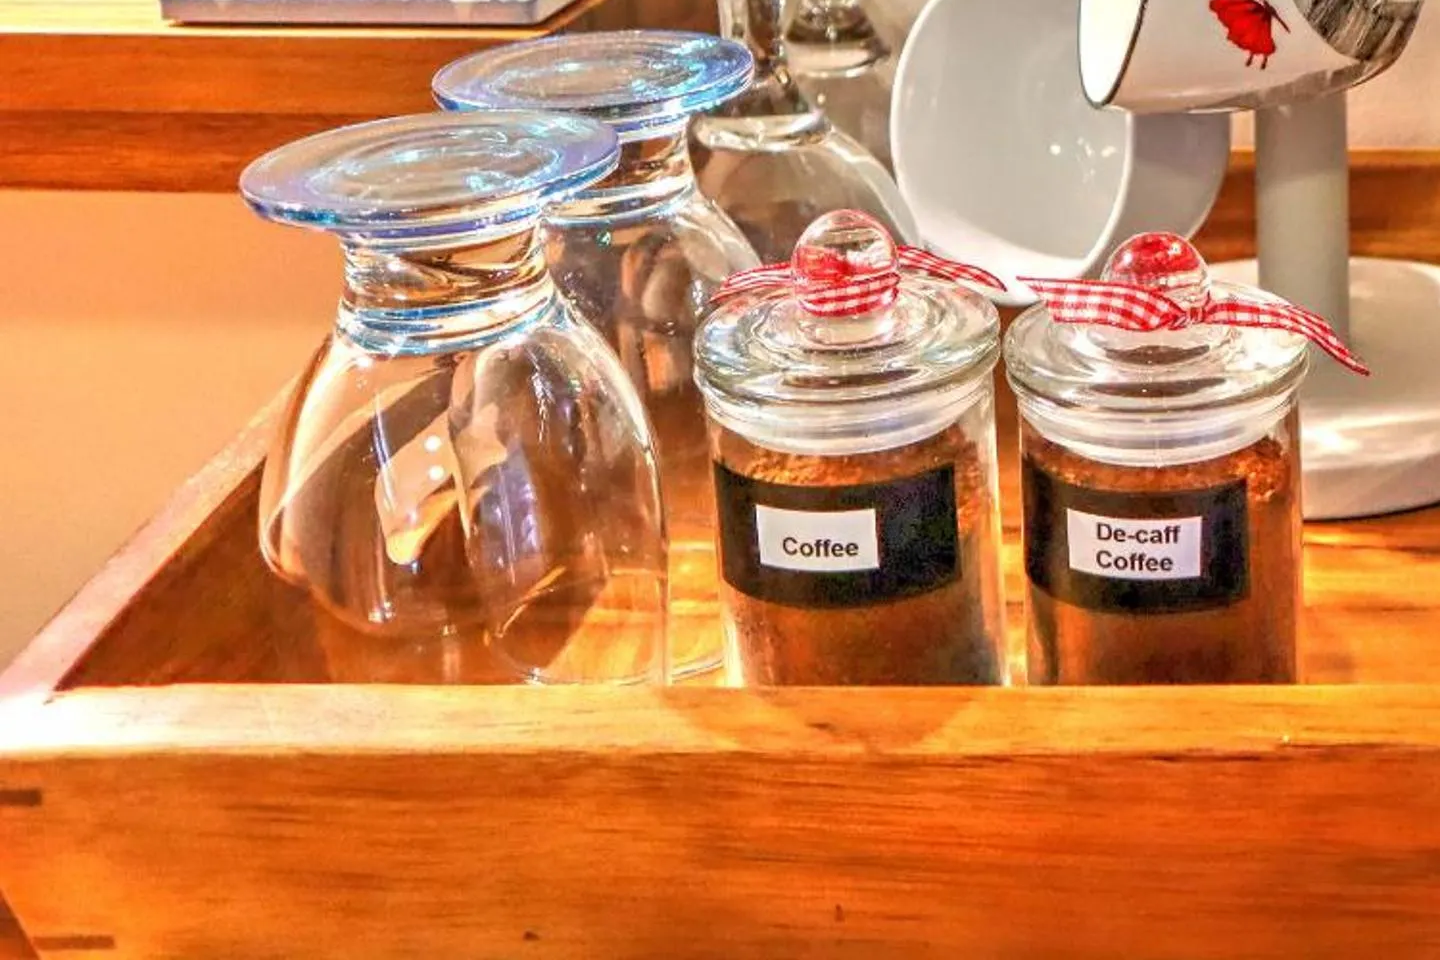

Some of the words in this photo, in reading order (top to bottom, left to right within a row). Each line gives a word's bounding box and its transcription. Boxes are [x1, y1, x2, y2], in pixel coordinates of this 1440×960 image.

[1096, 522, 1181, 544] De-caff
[782, 536, 859, 558] Coffee
[1096, 549, 1173, 572] Coffee
